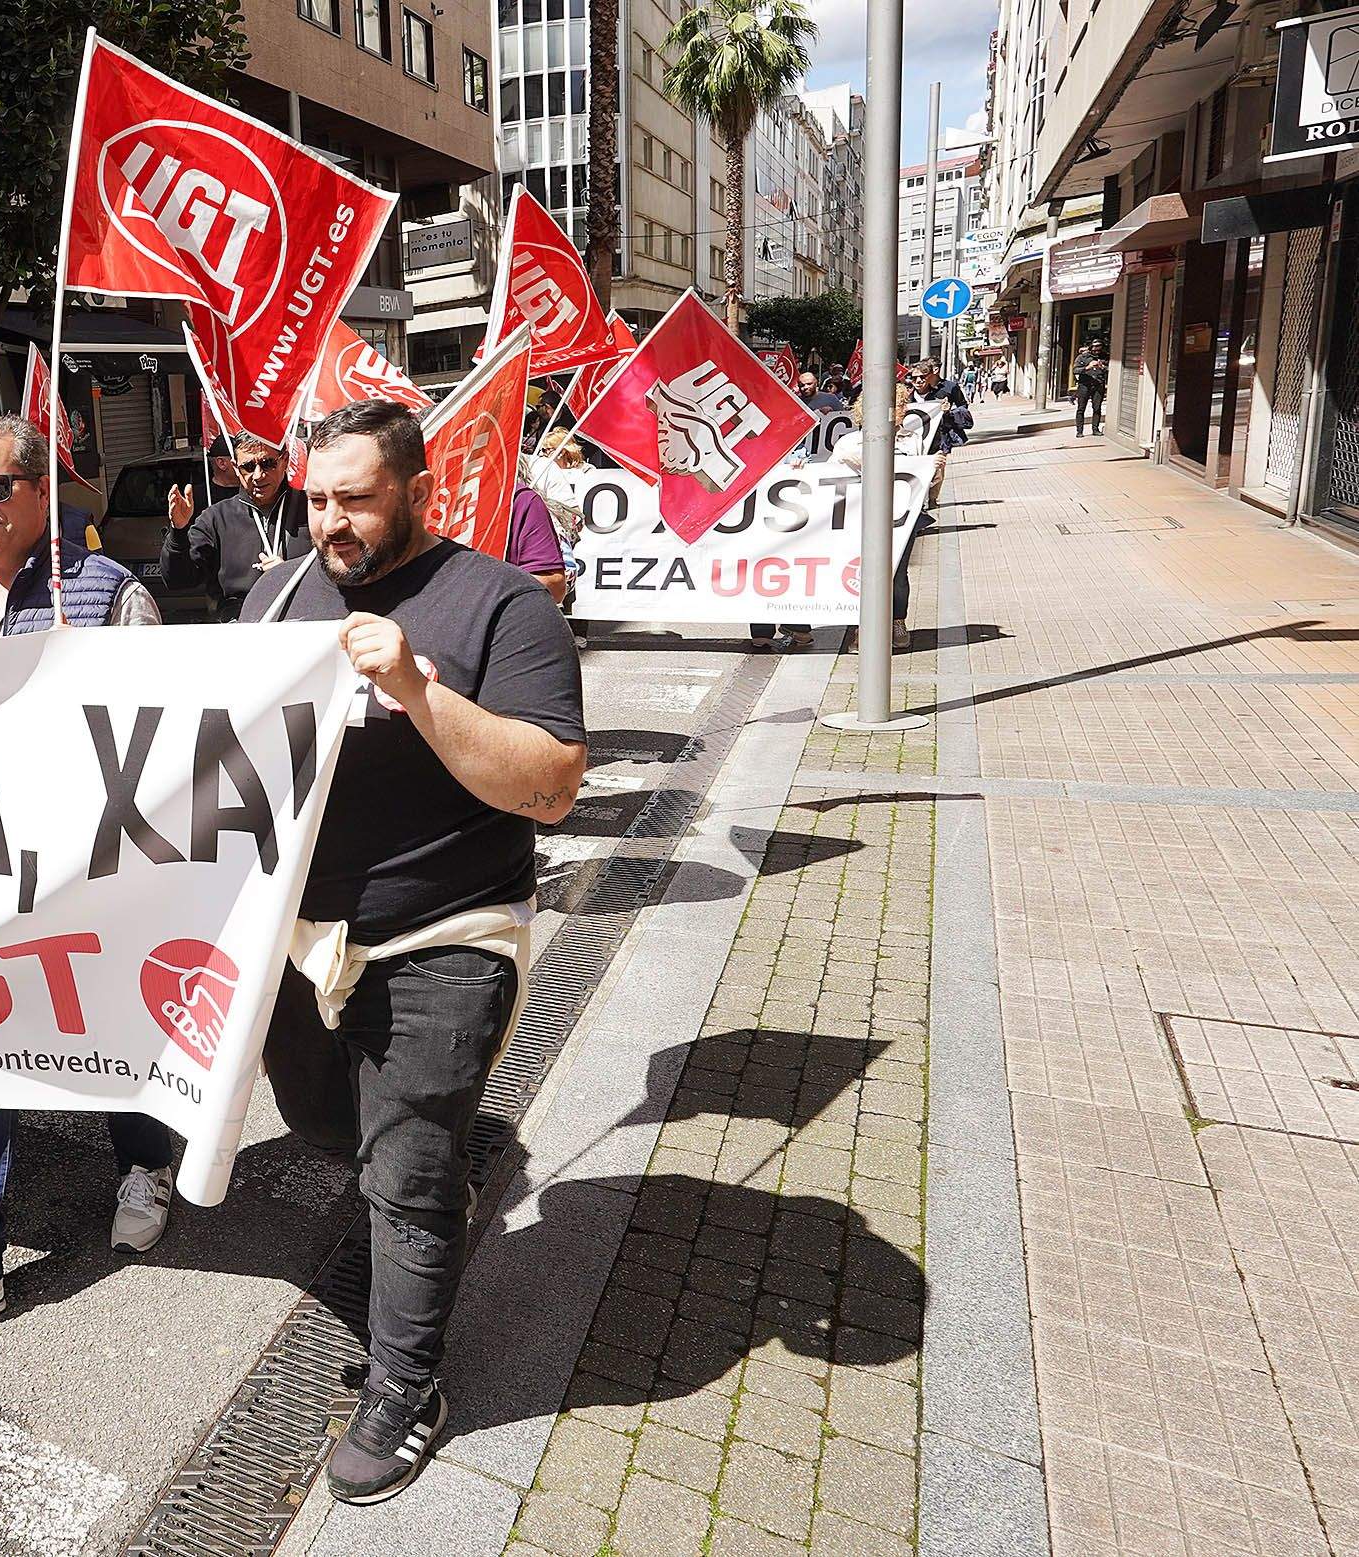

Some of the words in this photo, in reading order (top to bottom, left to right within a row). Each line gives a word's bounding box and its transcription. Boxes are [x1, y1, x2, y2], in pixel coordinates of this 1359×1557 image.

[120, 141, 271, 288] UGT
[441, 230, 452, 238] tu
[246, 203, 355, 409] www.UGT.es
[379, 296, 400, 311] BBVA
[512, 251, 580, 336] UGT
[669, 359, 771, 449] UGT
[711, 558, 830, 597] UGT
